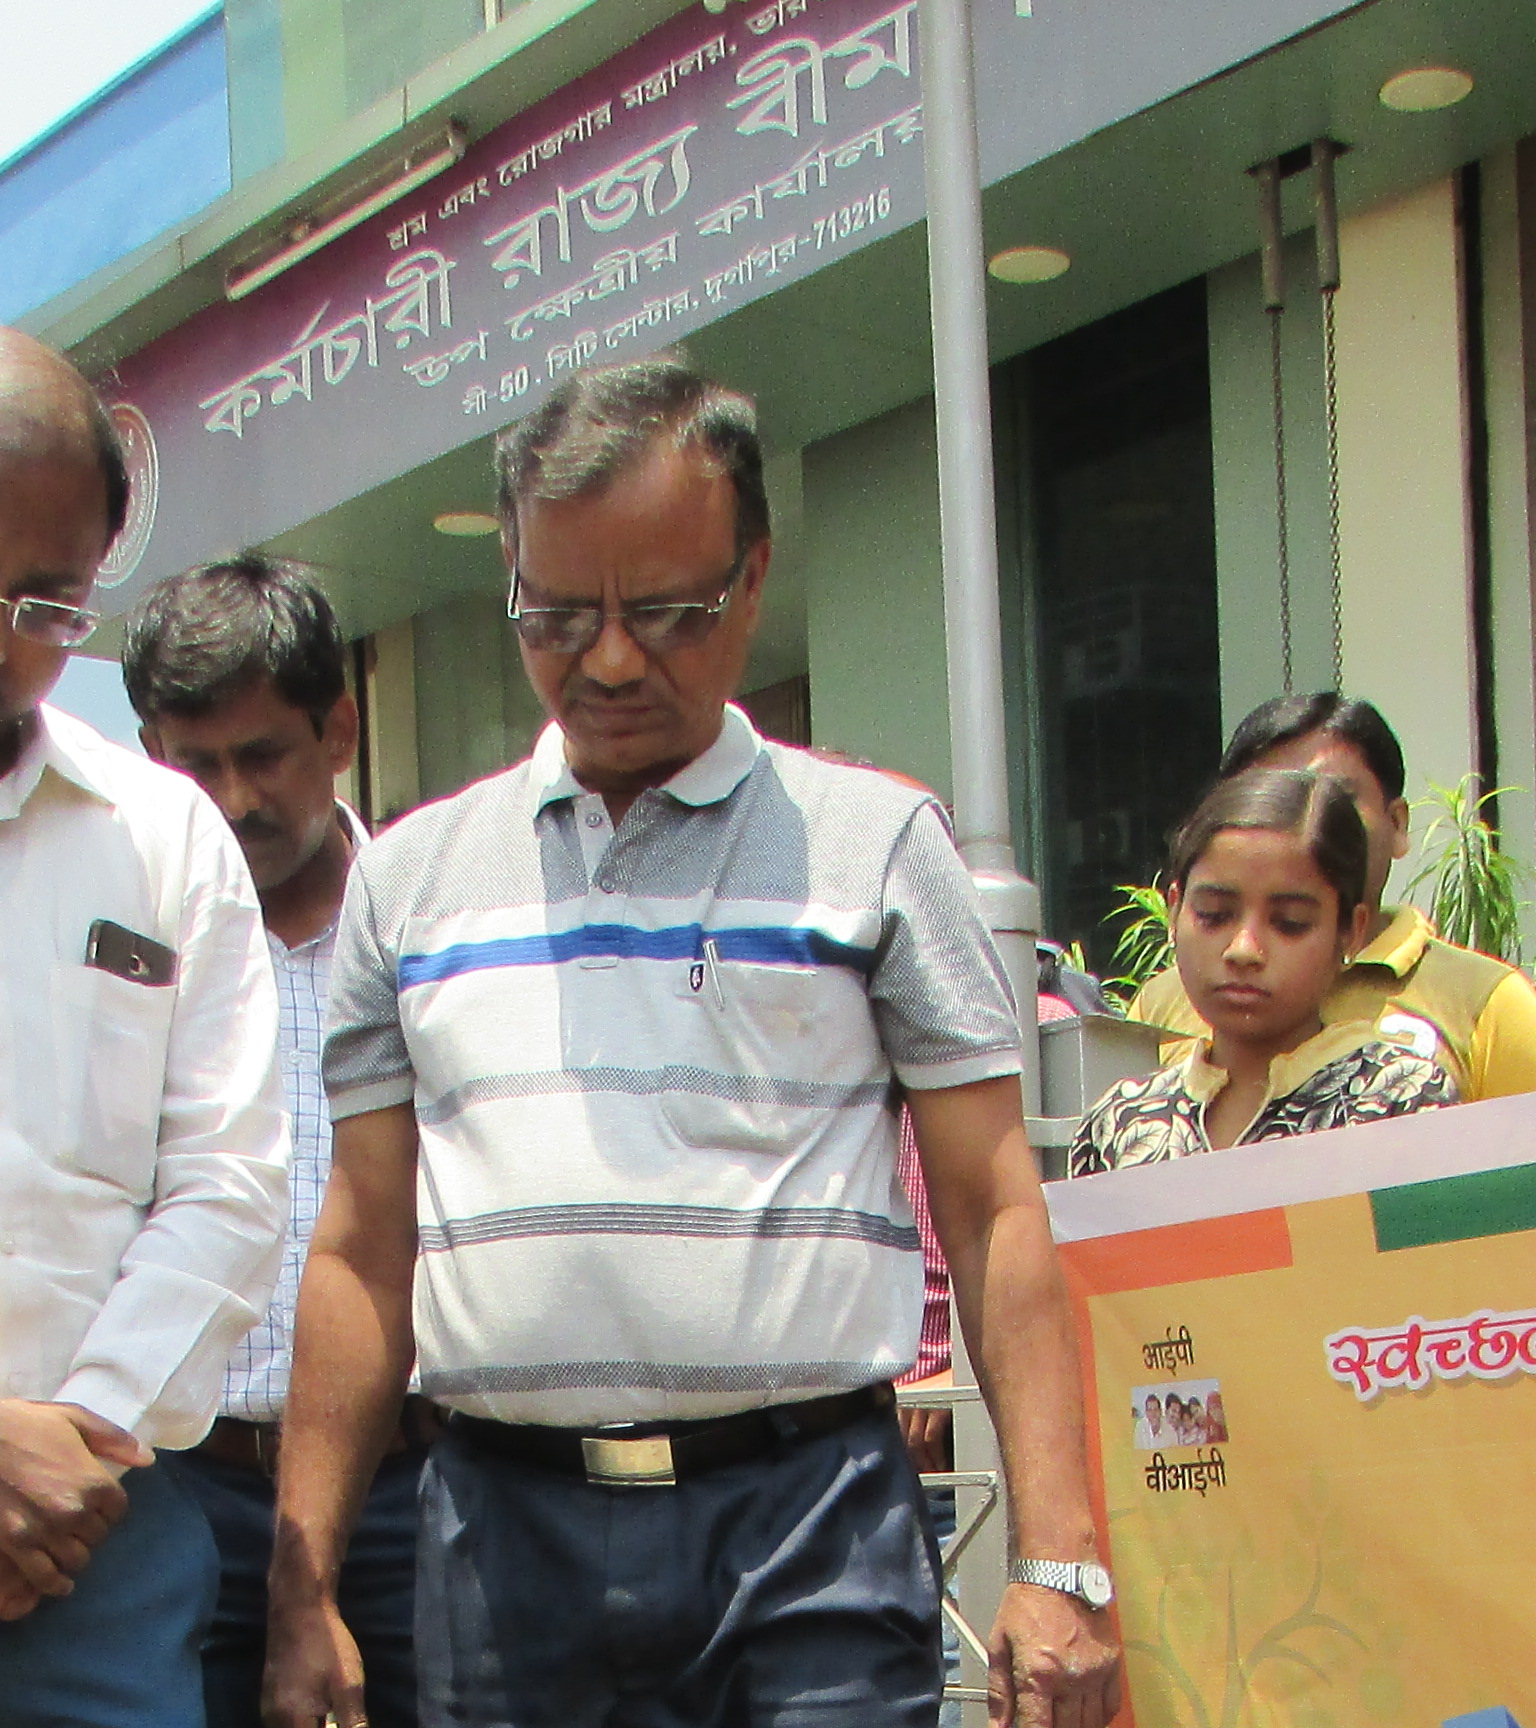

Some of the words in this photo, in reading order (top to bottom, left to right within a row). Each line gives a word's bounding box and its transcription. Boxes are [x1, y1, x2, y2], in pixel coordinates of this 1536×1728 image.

[438, 177, 491, 220] এবং
[496, 100, 612, 187] রোজগার
[745, 0, 810, 35] ভার
[198, 249, 457, 440] কর্মচারী
[483, 122, 700, 290] রাজ্য
[725, 1, 921, 137] বীম
[402, 328, 491, 388] উপ
[505, 231, 682, 342] ক্ষেত্রীয়
[1142, 1325, 1195, 1376] आईपी
[1144, 1447, 1227, 1498] वीआईपी
